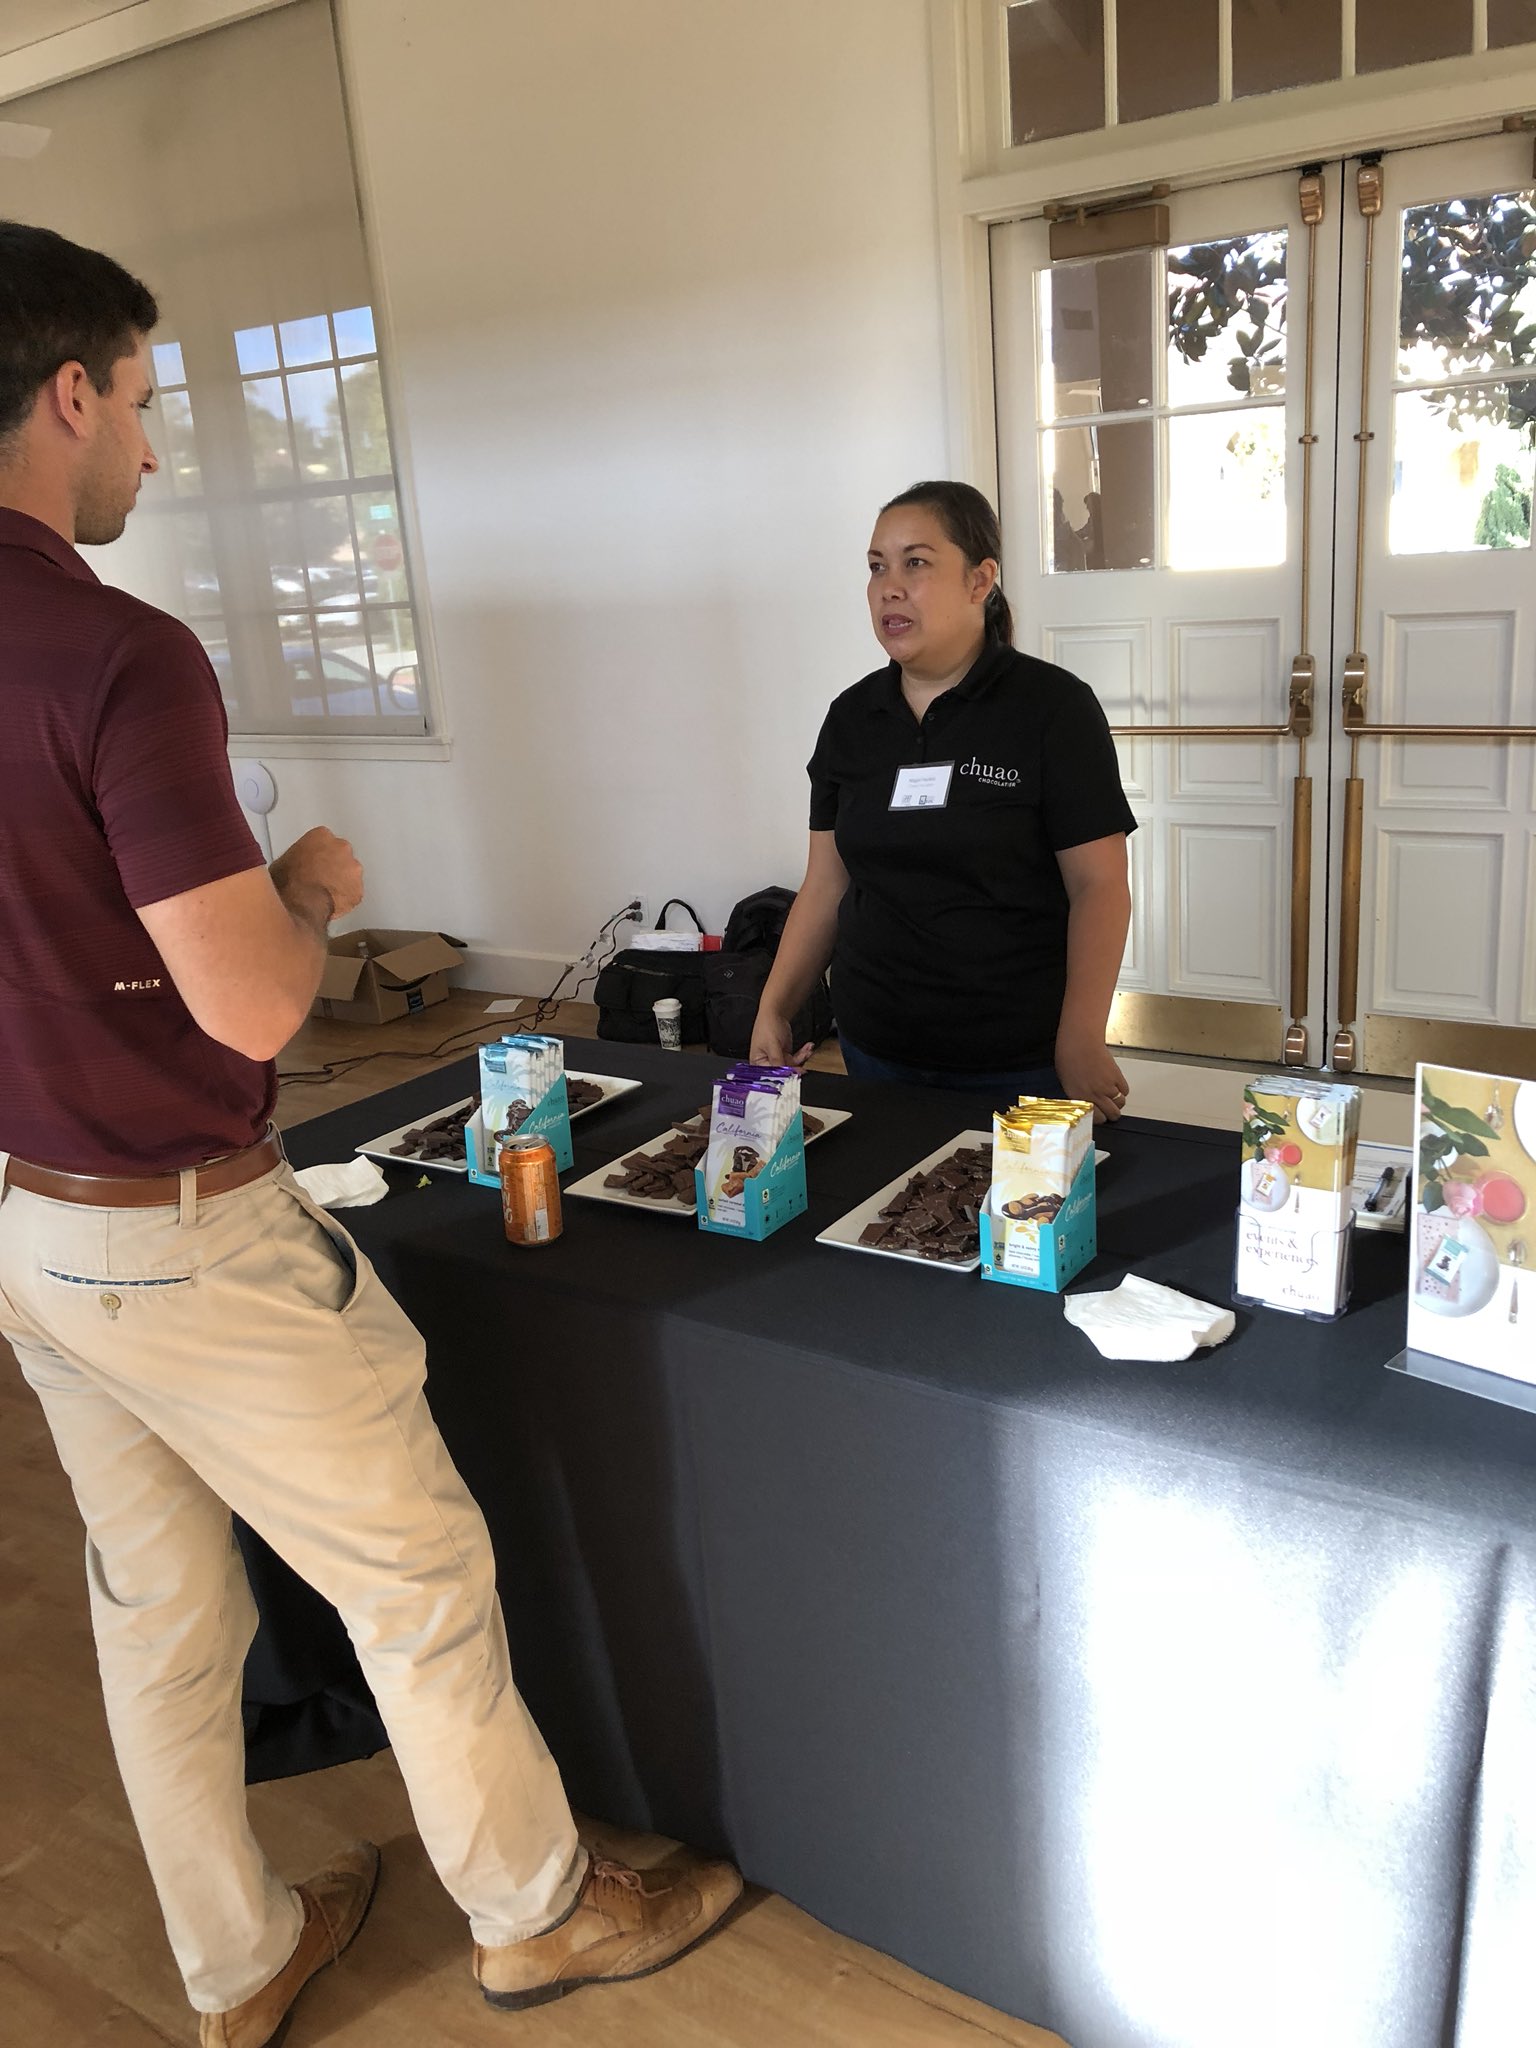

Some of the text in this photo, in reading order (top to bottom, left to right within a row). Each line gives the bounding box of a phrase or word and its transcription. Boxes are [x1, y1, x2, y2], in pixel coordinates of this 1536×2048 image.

[959, 756, 1019, 781] chuao
[978, 777, 1016, 788] CHOCOLATIER
[114, 978, 161, 991] M-FLEX
[721, 1094, 744, 1105] chuao
[529, 1112, 565, 1134] California
[716, 1123, 762, 1139] California
[770, 1151, 802, 1178] California
[1287, 1238, 1298, 1249] &
